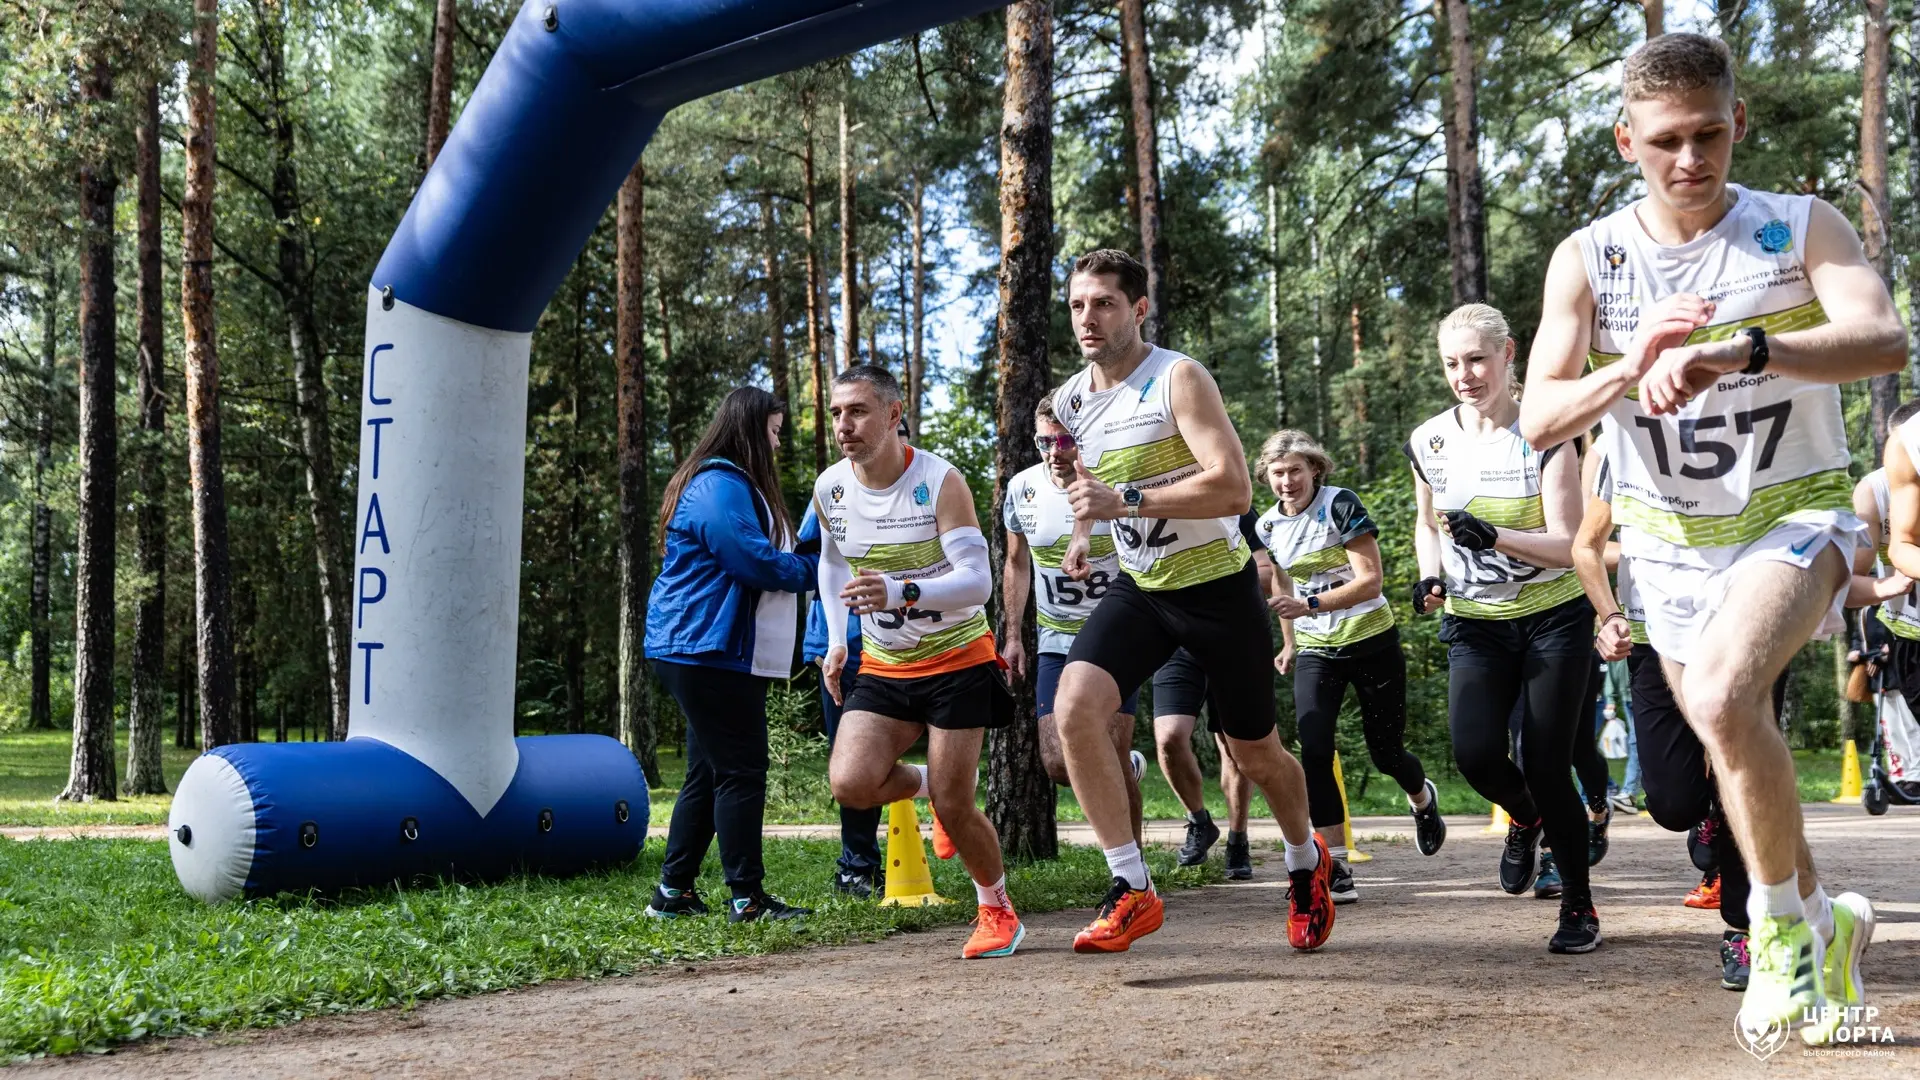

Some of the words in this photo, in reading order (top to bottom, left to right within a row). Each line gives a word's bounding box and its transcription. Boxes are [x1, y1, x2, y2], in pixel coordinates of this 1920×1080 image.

[1717, 373, 1780, 392] Выборгс
[1635, 399, 1792, 480] 157
[1170, 468, 1198, 485] район
[357, 343, 395, 705] СТАРТ
[1040, 571, 1110, 606] 158
